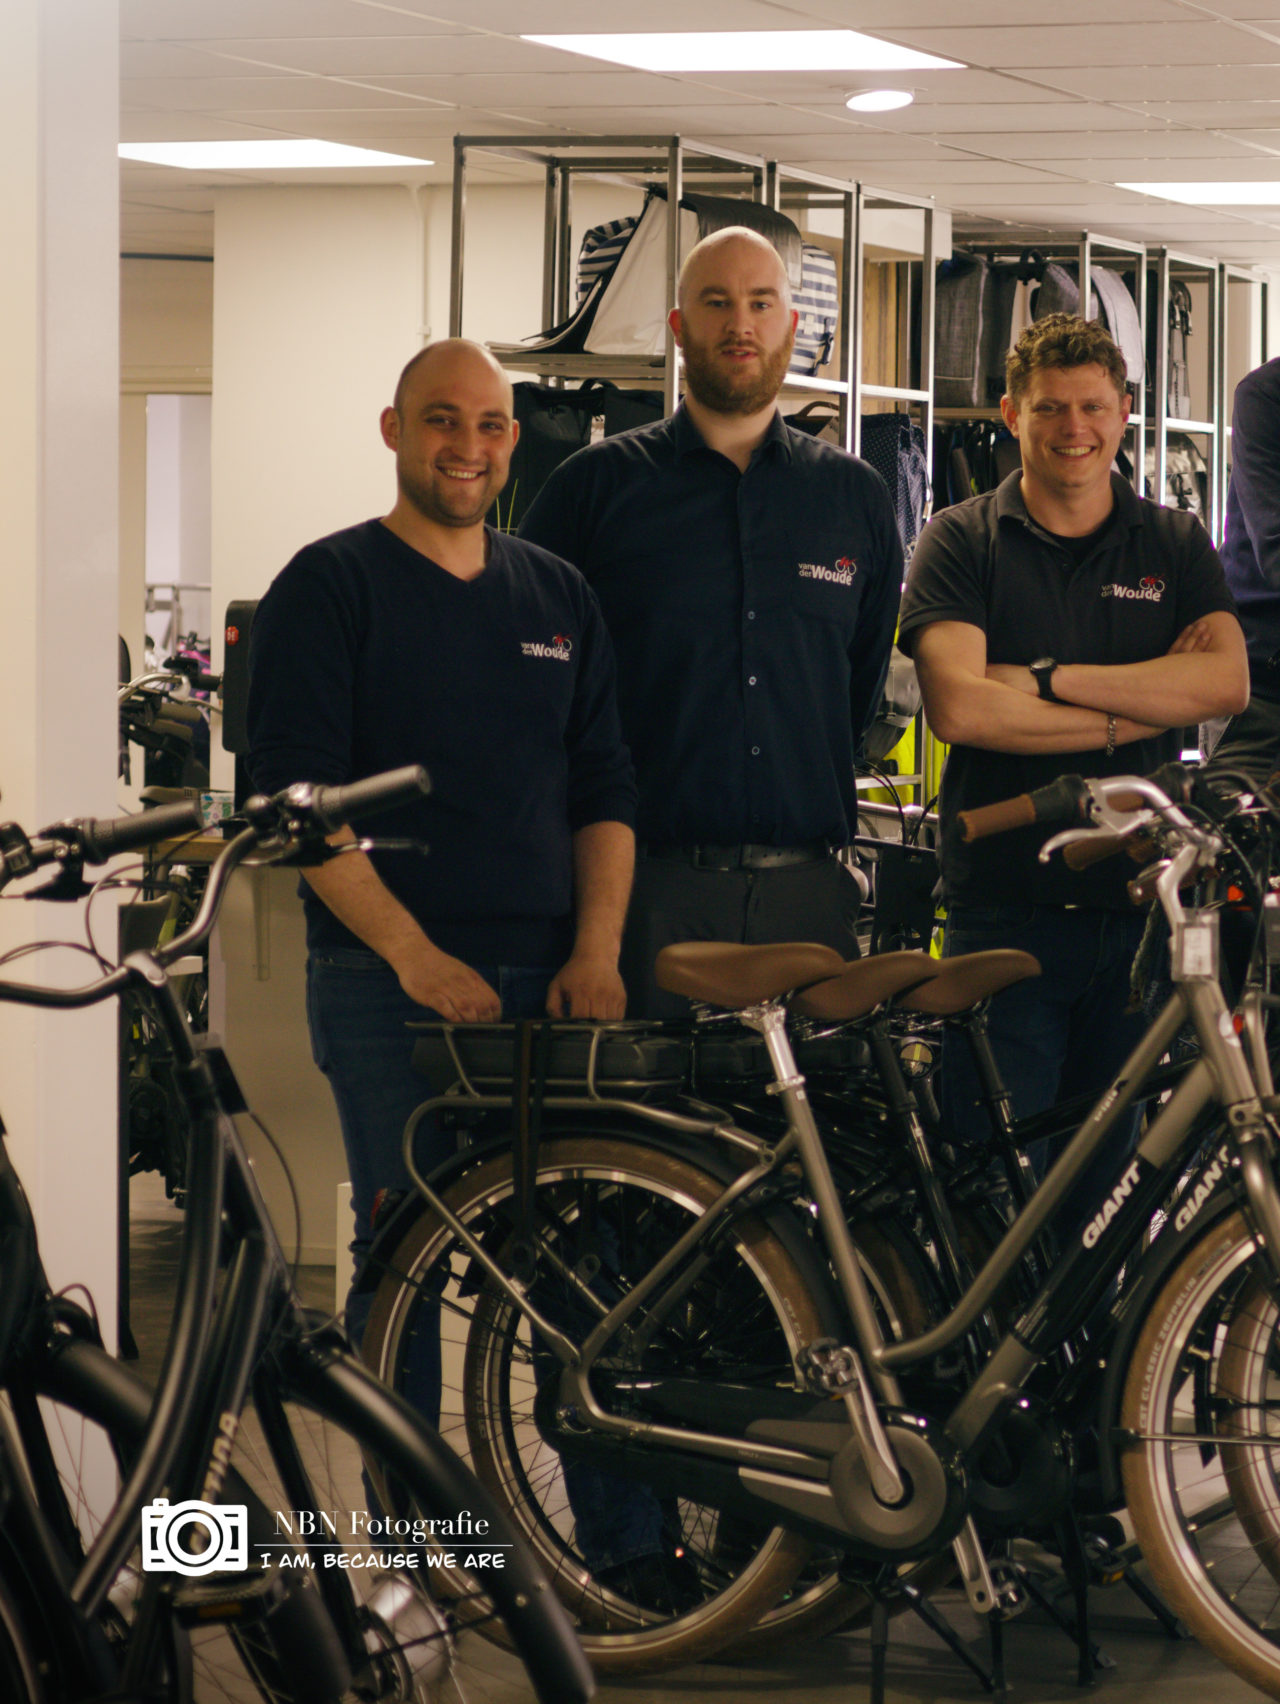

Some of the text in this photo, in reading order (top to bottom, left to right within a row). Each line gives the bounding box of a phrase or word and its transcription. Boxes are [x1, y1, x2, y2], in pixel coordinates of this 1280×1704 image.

[811, 565, 852, 586] Woude
[1112, 583, 1161, 602] Woude
[531, 643, 570, 661] Woude
[1175, 1145, 1229, 1232] GIANT
[1082, 1160, 1141, 1249] GIANT
